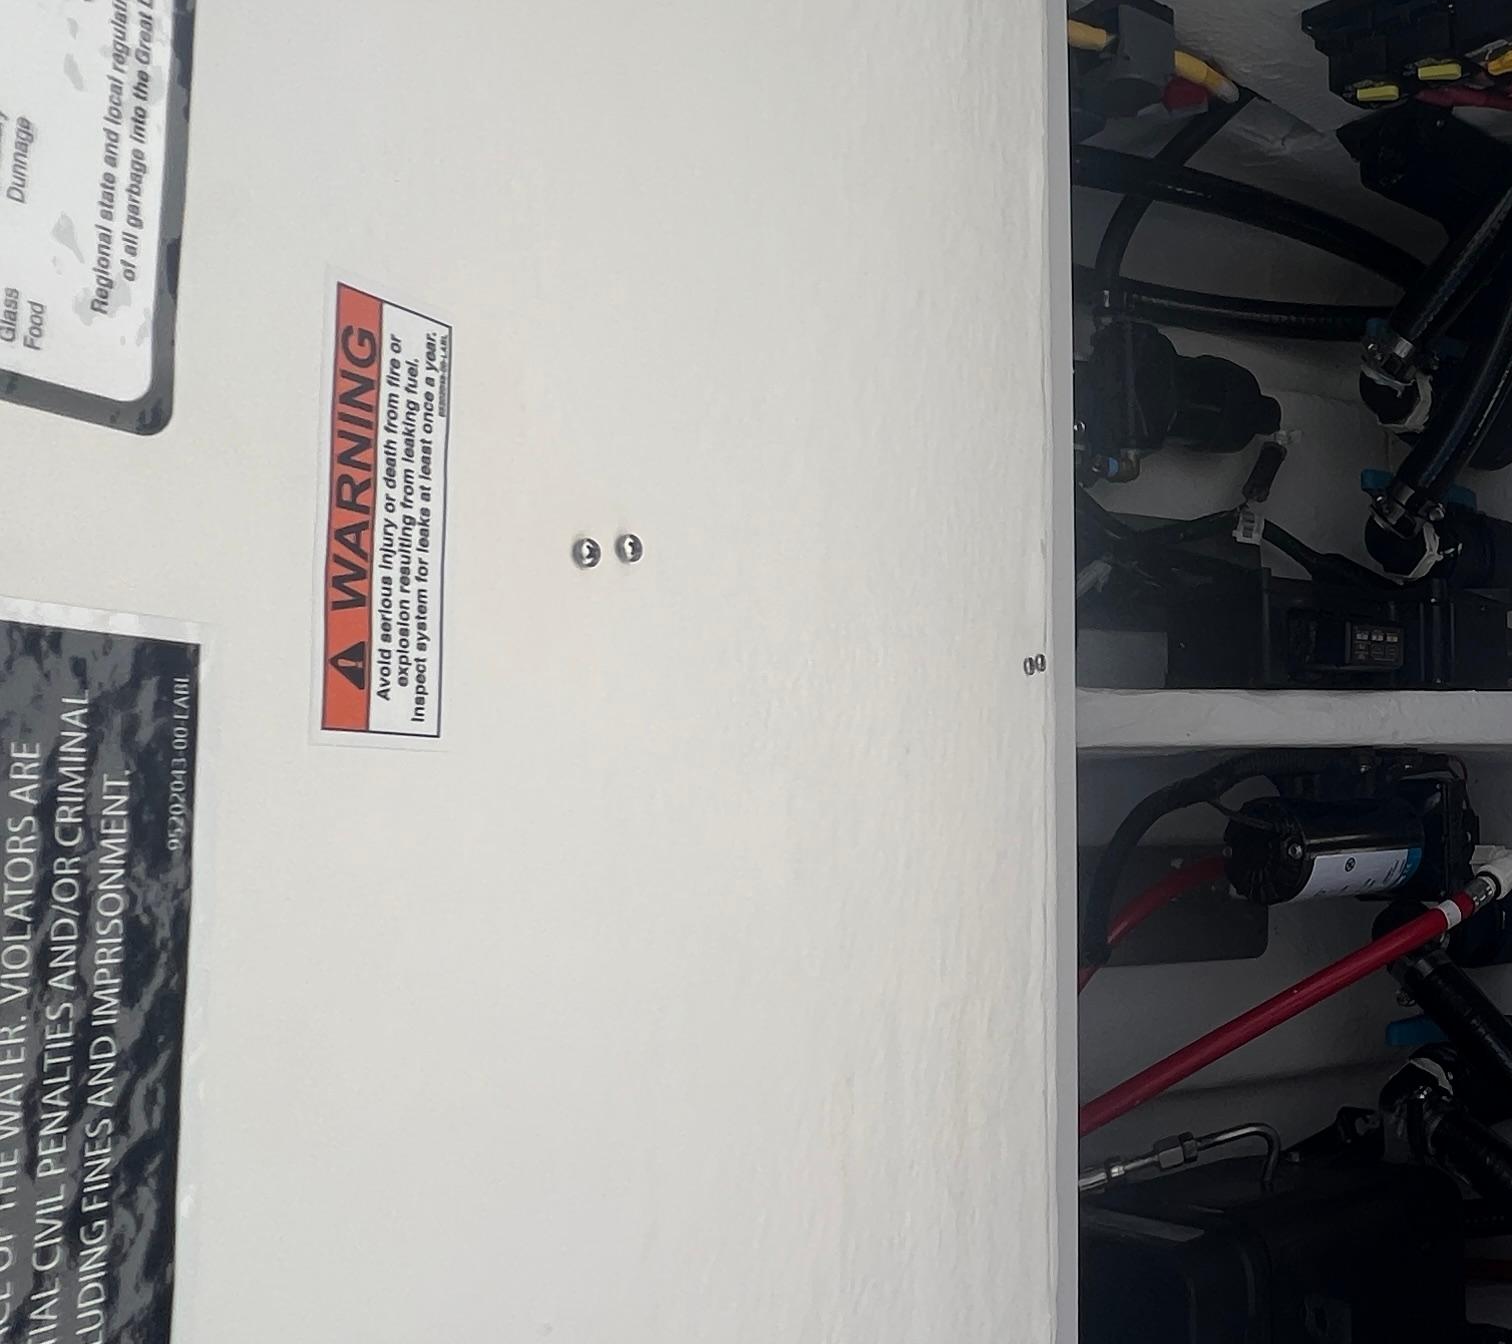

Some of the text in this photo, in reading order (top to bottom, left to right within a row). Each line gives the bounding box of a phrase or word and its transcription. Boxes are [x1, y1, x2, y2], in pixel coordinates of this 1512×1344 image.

[133, 11, 154, 66] Great
[104, 76, 125, 125] local
[129, 104, 148, 144] into
[132, 70, 150, 102] the
[6, 116, 34, 203] Dunnage
[102, 128, 121, 168] and
[124, 148, 146, 230] garbage
[98, 173, 117, 222] state
[91, 226, 113, 315] Regional
[120, 258, 138, 282] of
[122, 231, 140, 258] all
[0, 287, 20, 343] Glass
[23, 300, 44, 350] Food
[330, 324, 377, 612] WARNING
[375, 334, 403, 701] Avoid serious injury or death from fire or
[397, 357, 422, 687] explosion resulting from leaking fuel.
[411, 332, 440, 723] Inspect system for leaks at least once a year.
[8, 740, 41, 805] ARE
[54, 689, 90, 847] CRIMINAL
[0, 814, 37, 1003] VIOLATORS
[49, 857, 82, 991] AND/OR
[91, 768, 131, 1025] IMPRISONMENT.
[0, 1015, 26, 1139] WATER.
[37, 1002, 75, 1177] PENALTIES
[87, 1036, 117, 1108] AND
[81, 1118, 113, 1211] FINES
[32, 1184, 66, 1271] CIVIL
